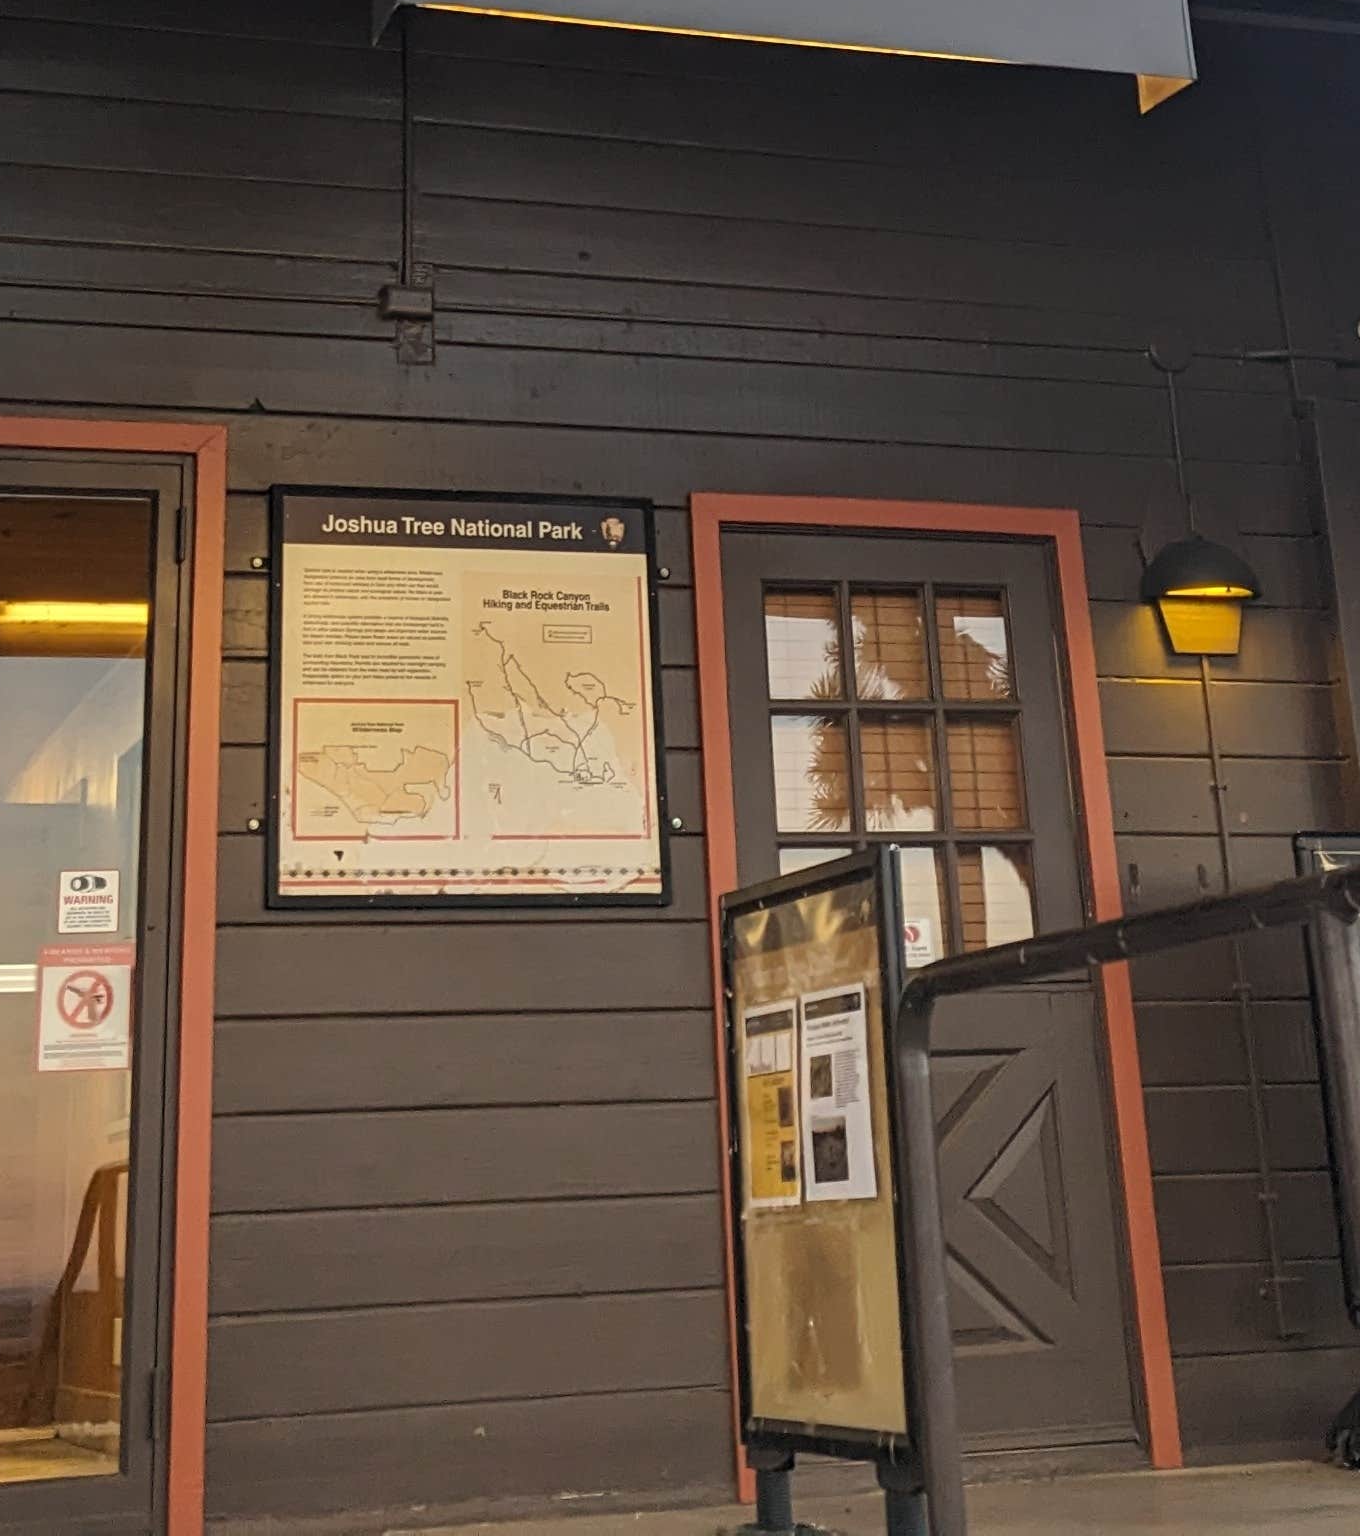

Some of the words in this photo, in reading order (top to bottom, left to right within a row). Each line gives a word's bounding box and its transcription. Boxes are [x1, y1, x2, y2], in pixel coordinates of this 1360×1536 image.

[322, 515, 398, 535] Joshua
[401, 517, 445, 535] Tree
[451, 519, 532, 538] National
[539, 521, 583, 540] Park
[502, 589, 528, 599] Black
[530, 590, 554, 600] Rock
[556, 591, 591, 602] Canyon
[482, 599, 513, 611] Hiking
[515, 600, 533, 609] and
[535, 600, 583, 612] Equestrian
[585, 602, 610, 611] Trails
[63, 895, 114, 905] WARNING
